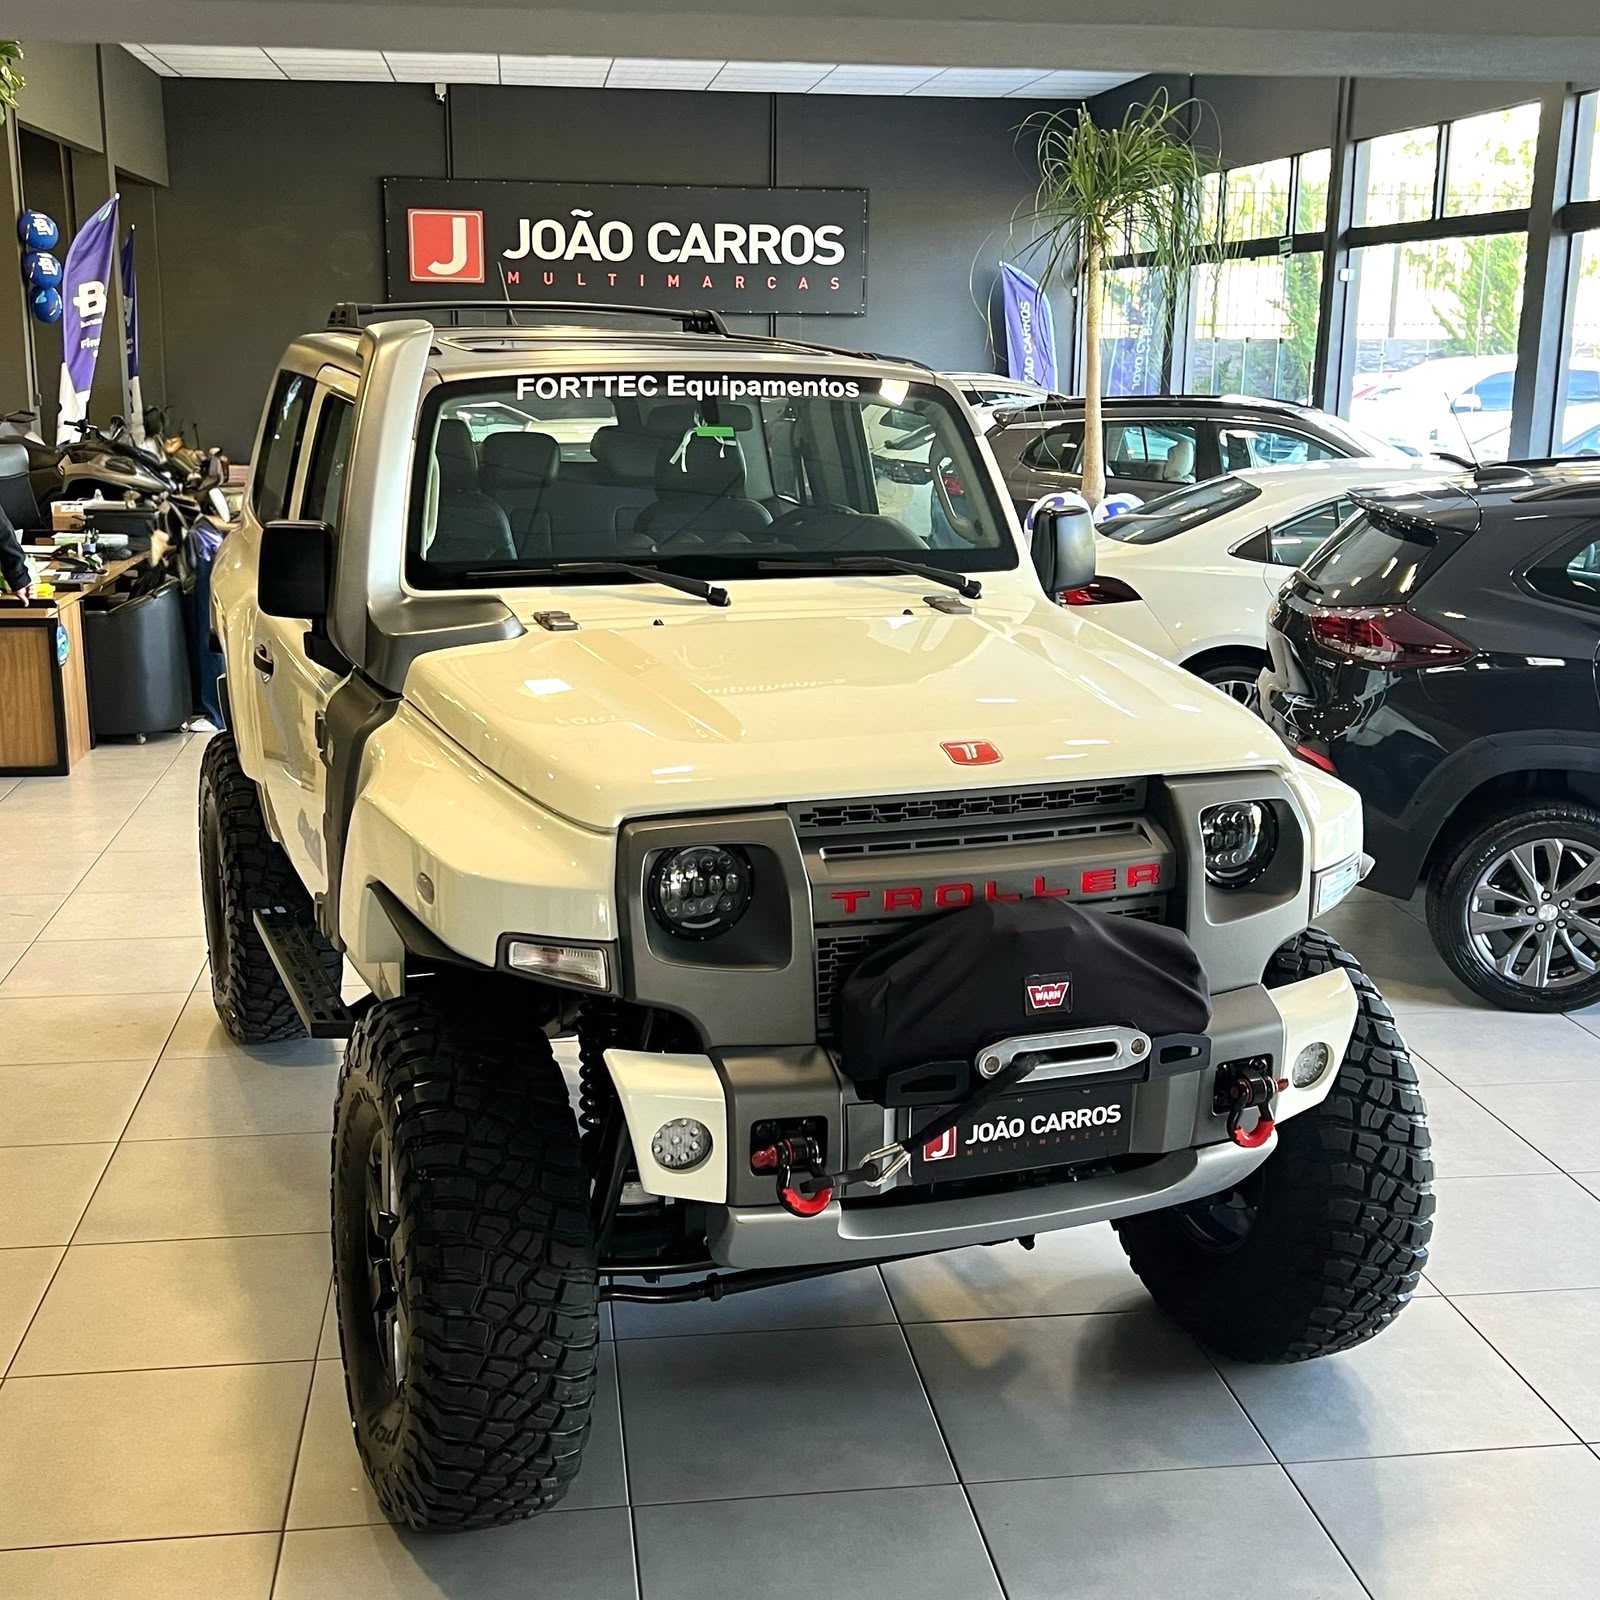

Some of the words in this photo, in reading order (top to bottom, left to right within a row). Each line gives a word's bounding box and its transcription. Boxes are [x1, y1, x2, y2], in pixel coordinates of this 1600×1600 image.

[427, 216, 468, 276] J
[502, 208, 635, 262] JOÃO
[647, 221, 846, 266] CARROS
[507, 271, 841, 290] MULTIMARCAS
[516, 374, 658, 400] FORTTEC
[667, 375, 860, 401] Equipamentos
[831, 863, 1161, 914] TROLLER
[965, 1115, 1025, 1145] JOÃO
[1030, 1104, 1121, 1135] CARROS
